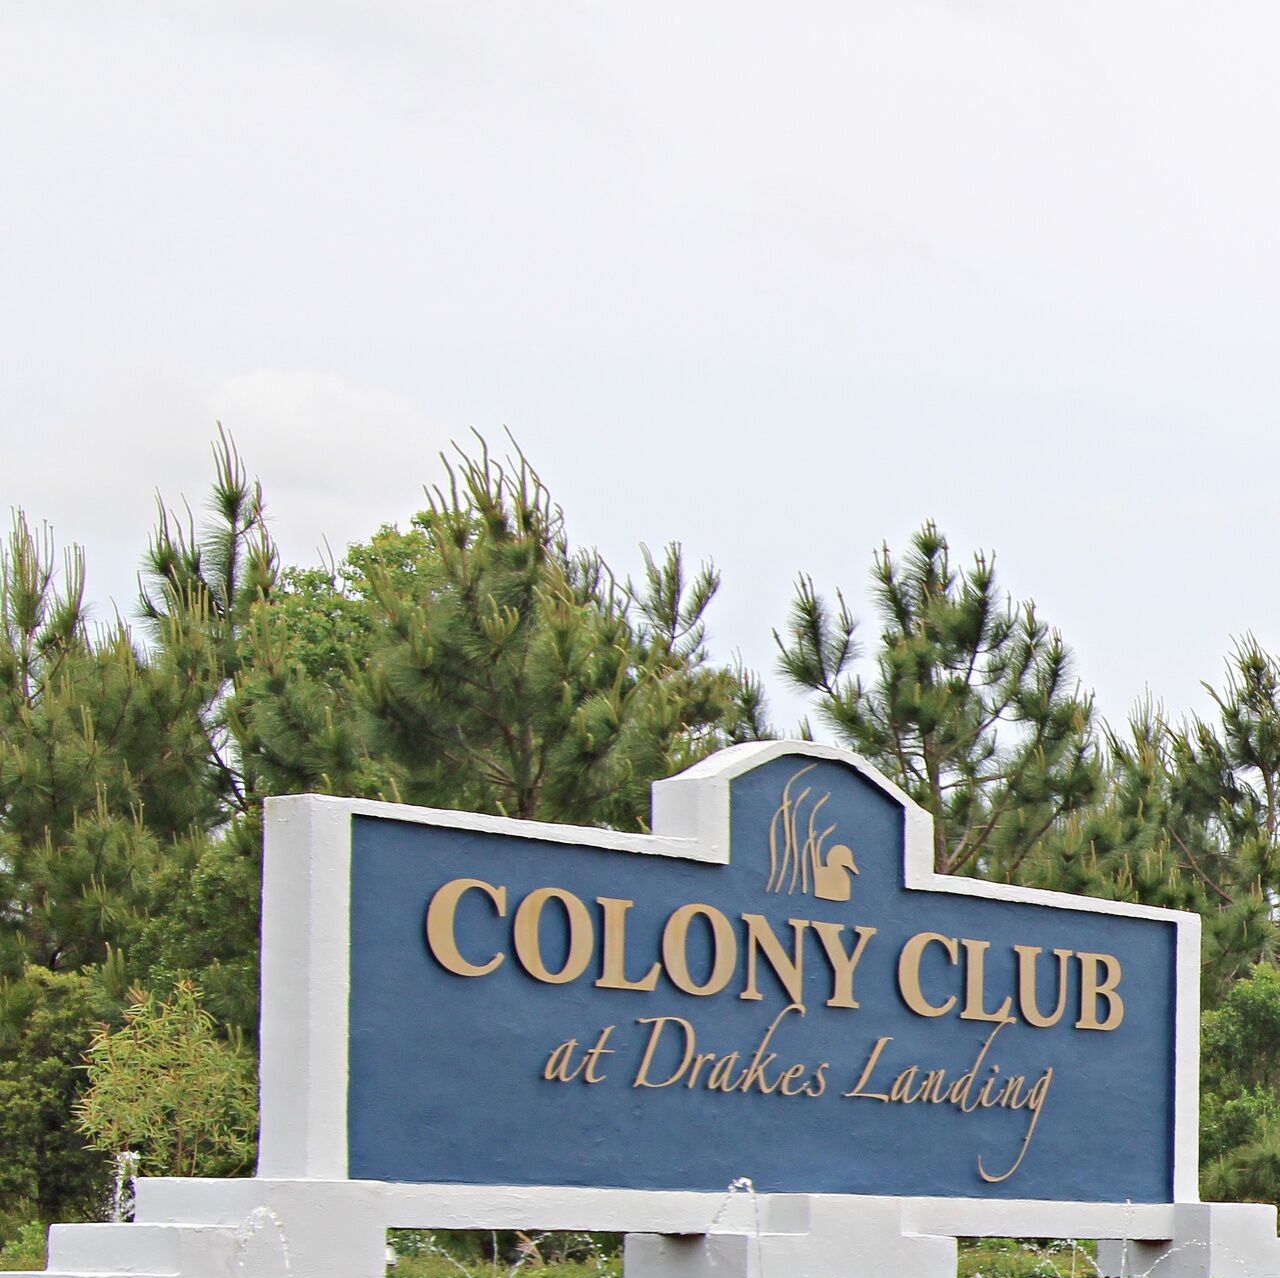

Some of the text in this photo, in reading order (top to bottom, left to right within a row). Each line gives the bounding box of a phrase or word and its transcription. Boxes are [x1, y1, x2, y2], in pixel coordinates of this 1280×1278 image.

[426, 878, 1125, 1031] COLONY CLUB
[543, 1003, 1054, 1183] at Drakes Landing
